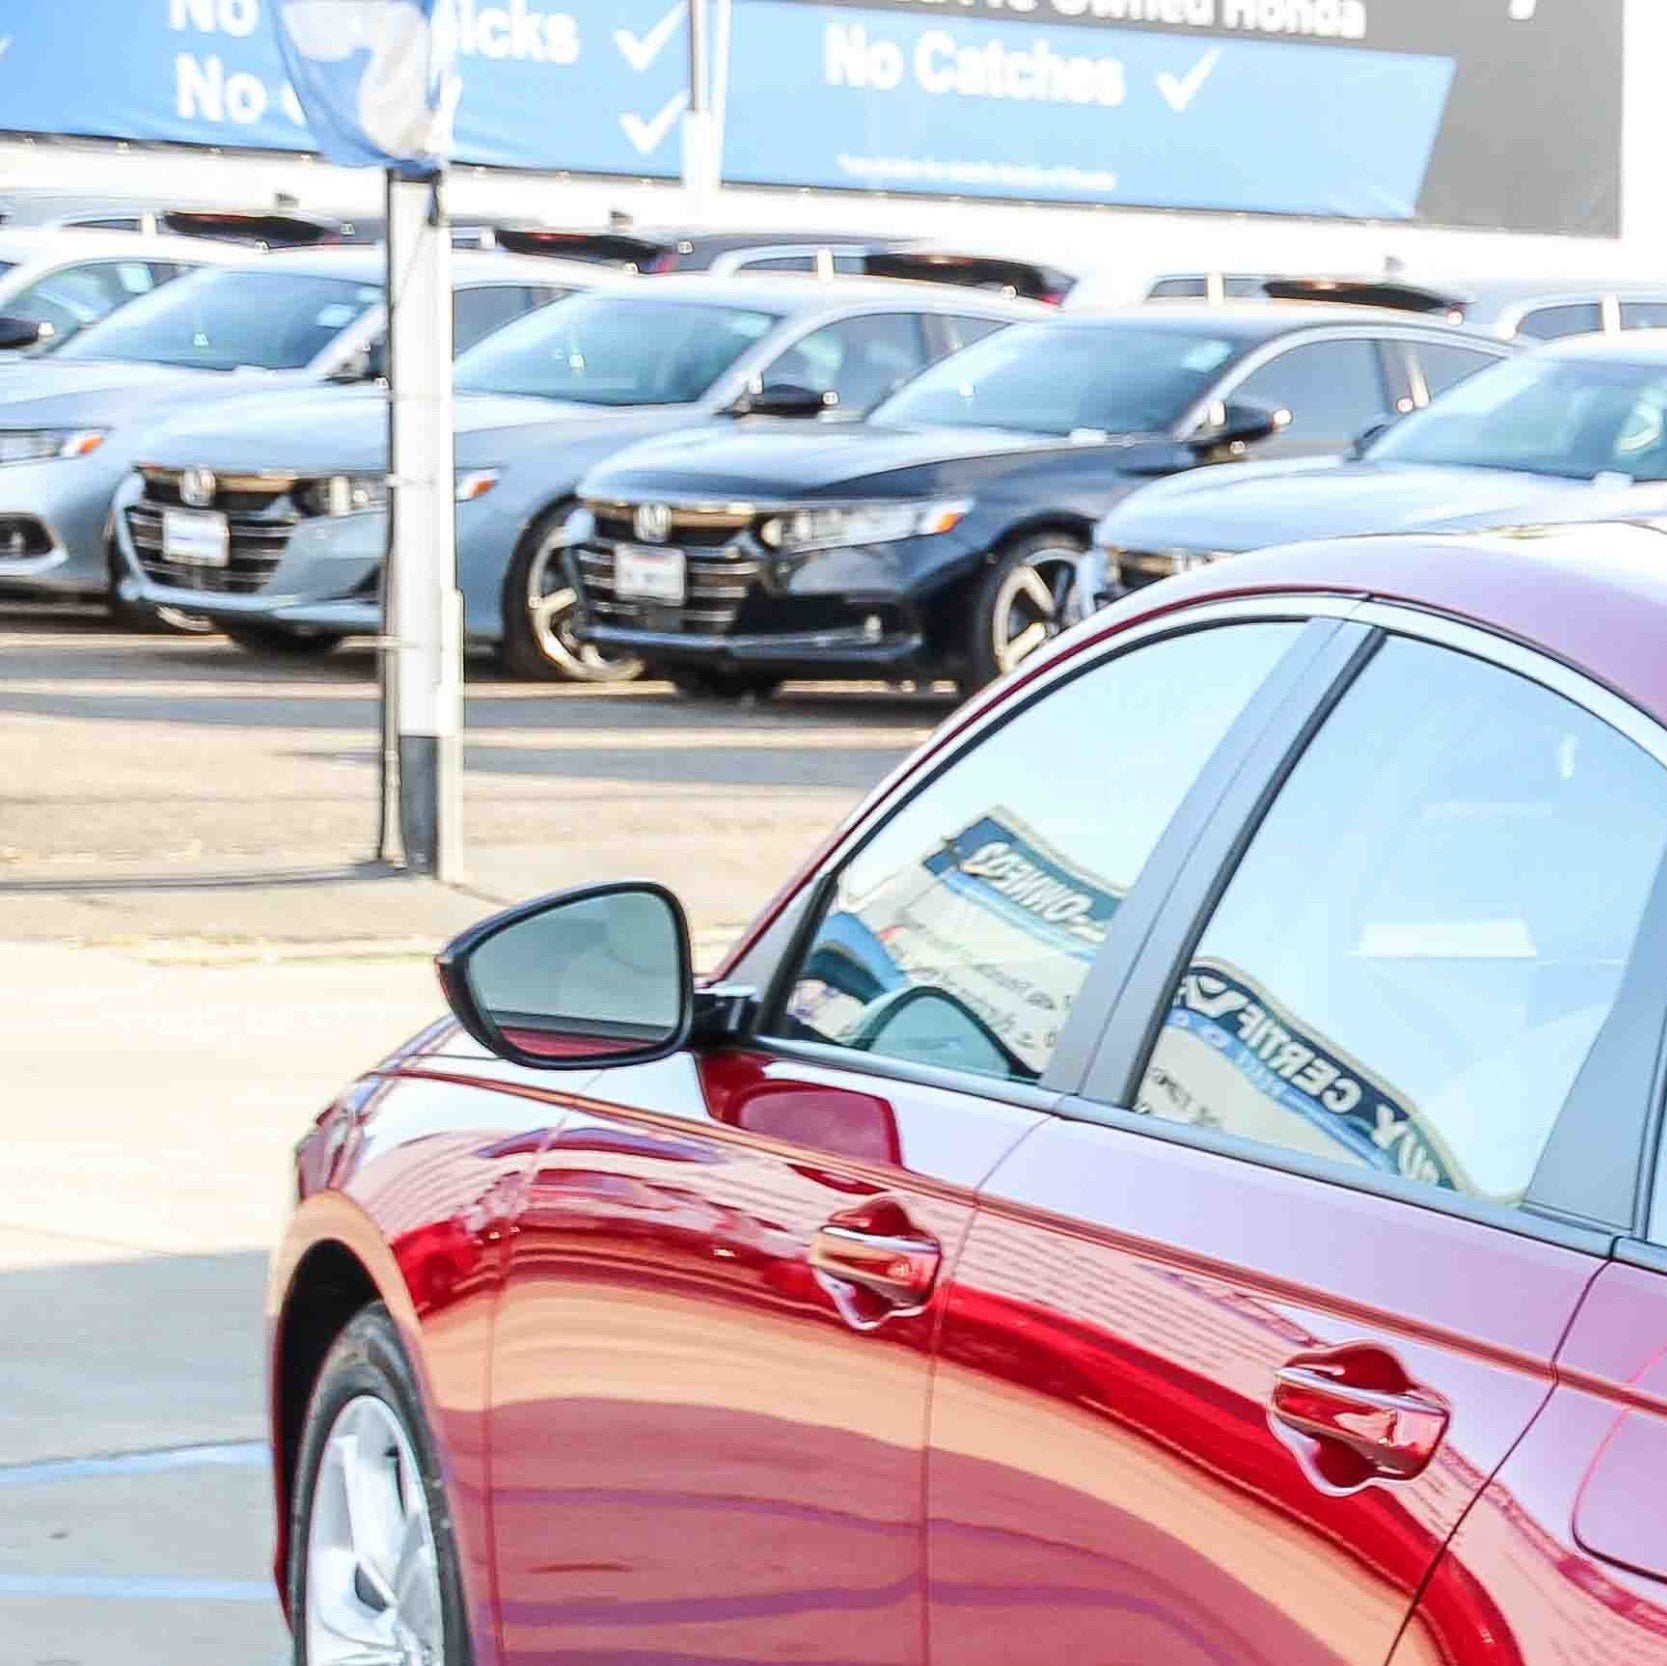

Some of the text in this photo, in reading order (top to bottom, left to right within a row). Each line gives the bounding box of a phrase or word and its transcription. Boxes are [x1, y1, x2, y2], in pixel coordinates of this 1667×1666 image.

[175, 51, 269, 124] No
[824, 20, 1126, 107] No Catches
